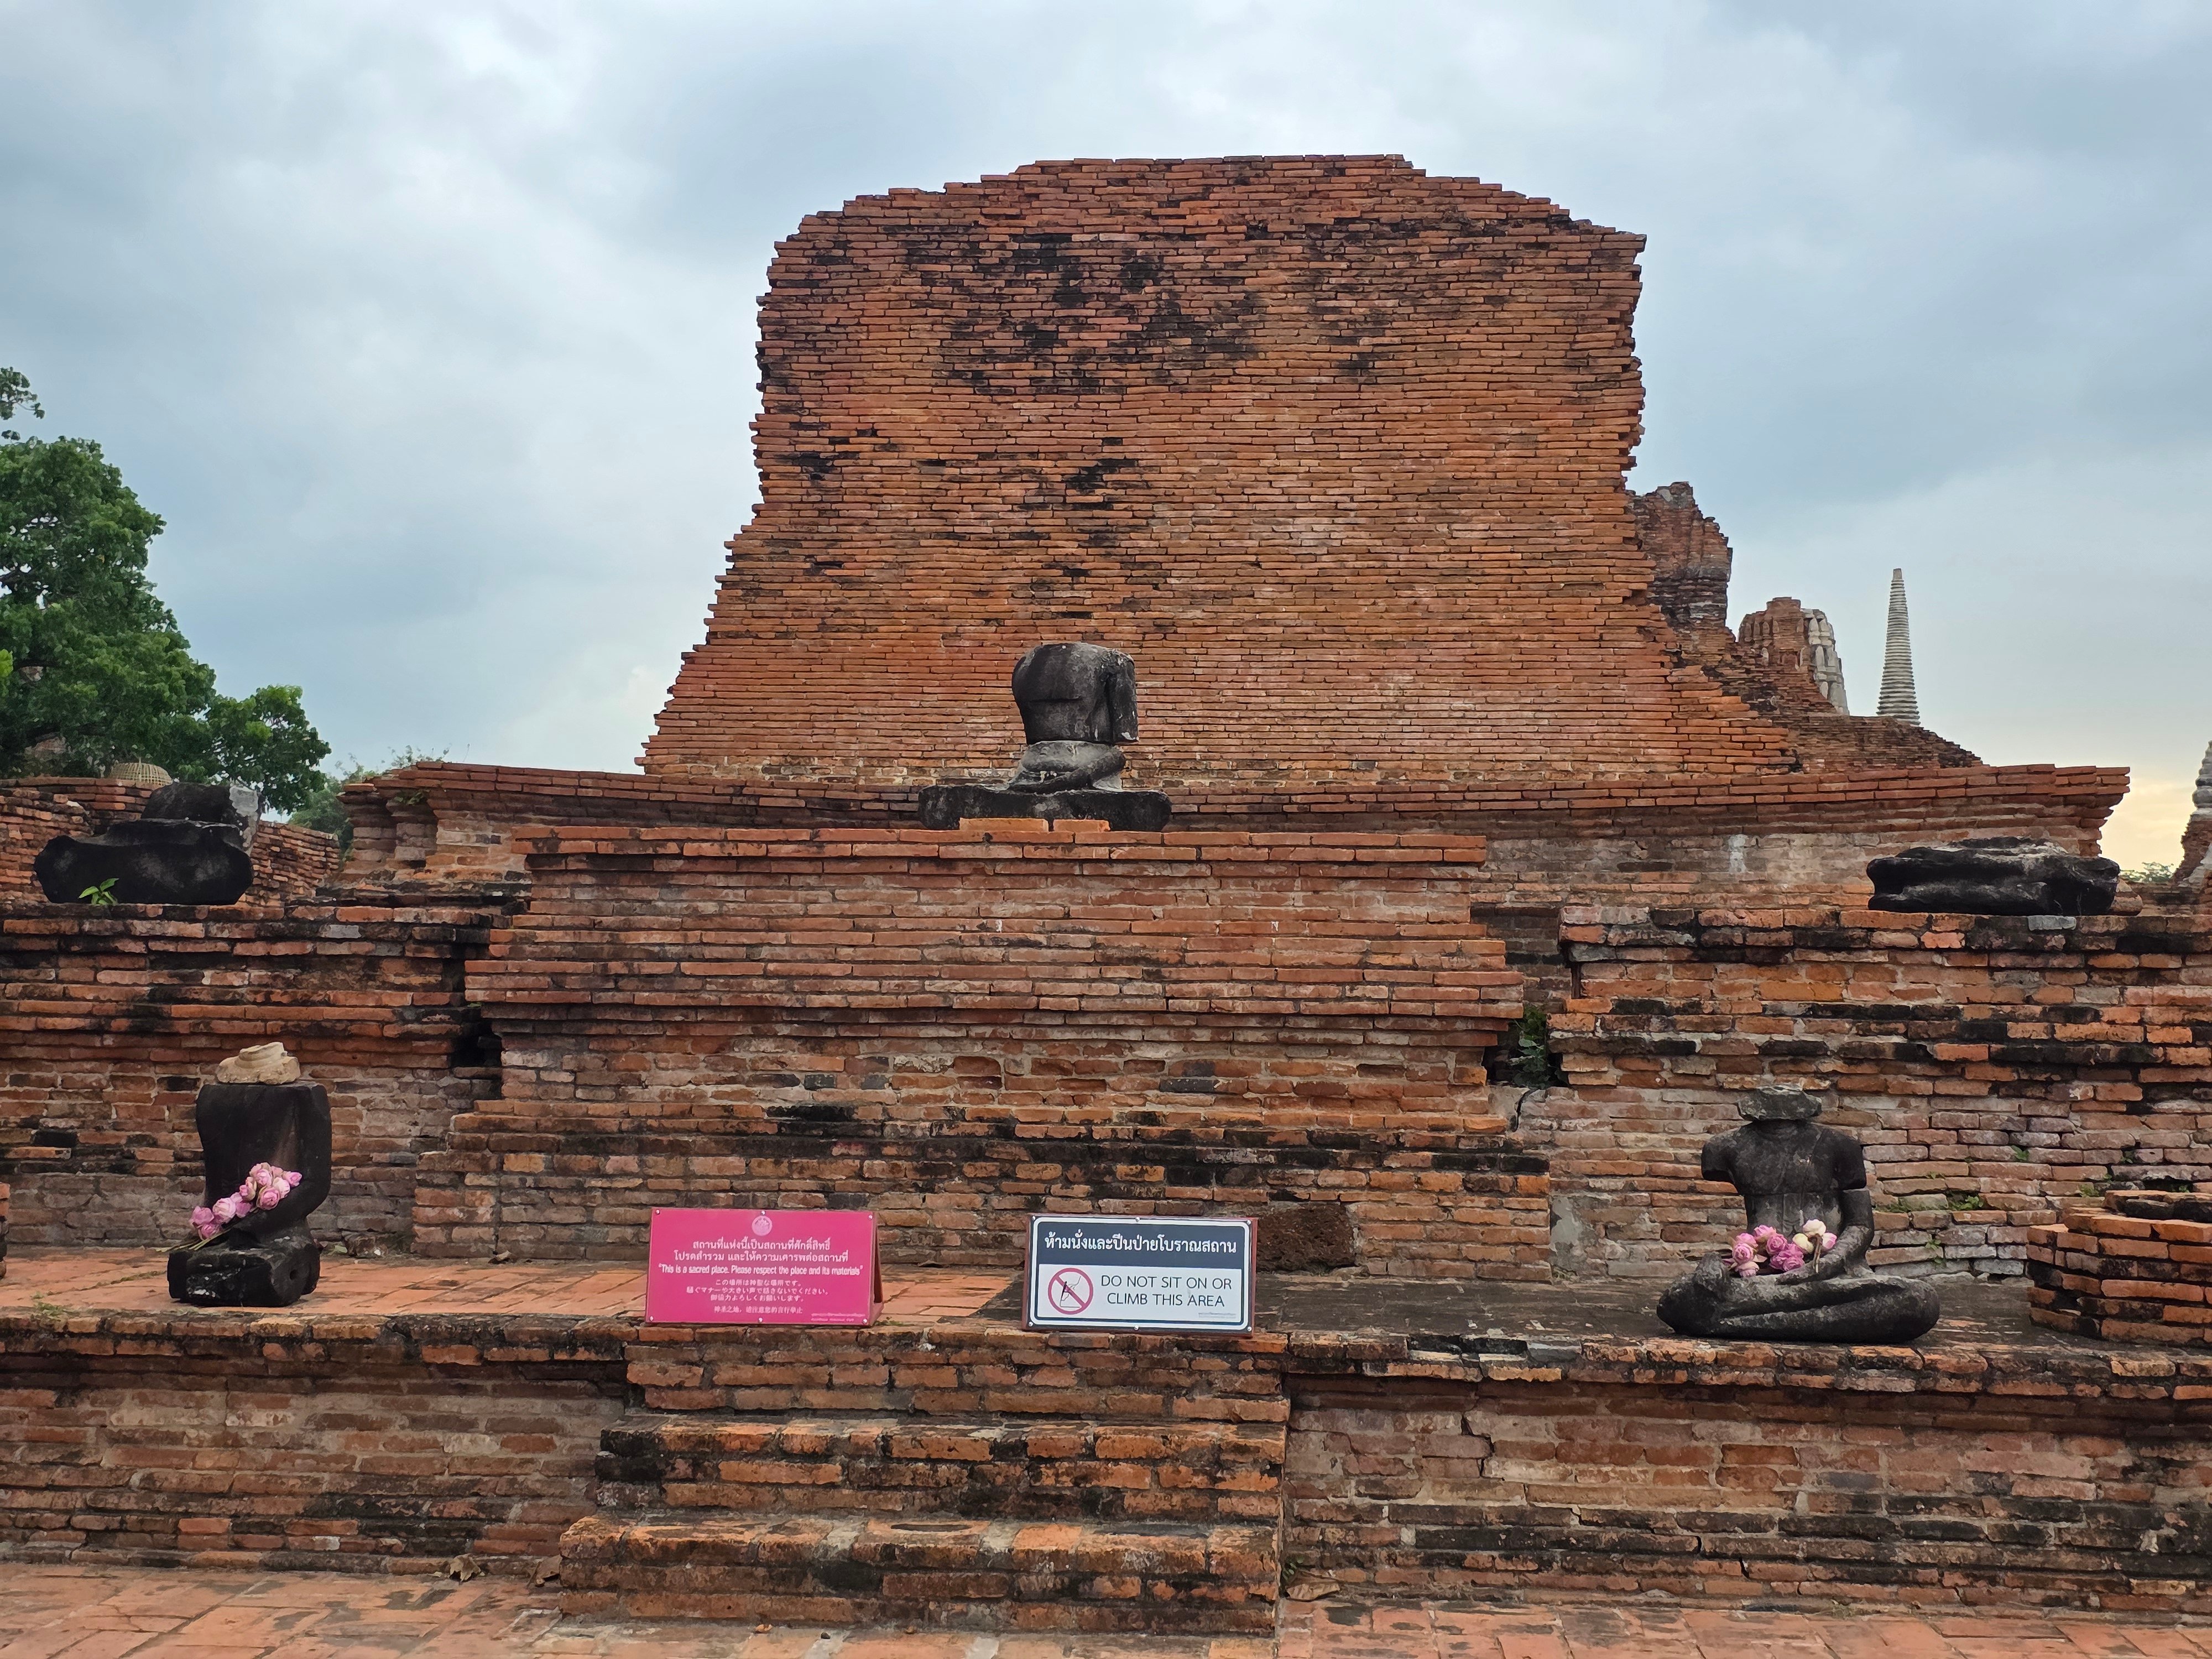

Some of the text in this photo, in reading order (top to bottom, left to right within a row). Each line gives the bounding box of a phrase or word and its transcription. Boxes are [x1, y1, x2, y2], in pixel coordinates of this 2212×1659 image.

[1045, 1229, 1237, 1254] ห้ามนั่งและปีนป่ายโบราณสถาน
[674, 1250, 724, 1261] โปรดสำรวม
[676, 1264, 681, 1274] is
[688, 1265, 709, 1274] sacred
[731, 1265, 752, 1274] Please
[753, 1266, 776, 1275] respect
[779, 1266, 789, 1275] the
[790, 1266, 807, 1276] place
[809, 1266, 820, 1275] and
[1101, 1275, 1232, 1290] DO NOT SIT ON OR
[1107, 1292, 1224, 1307] CLIMB THIS AREA
